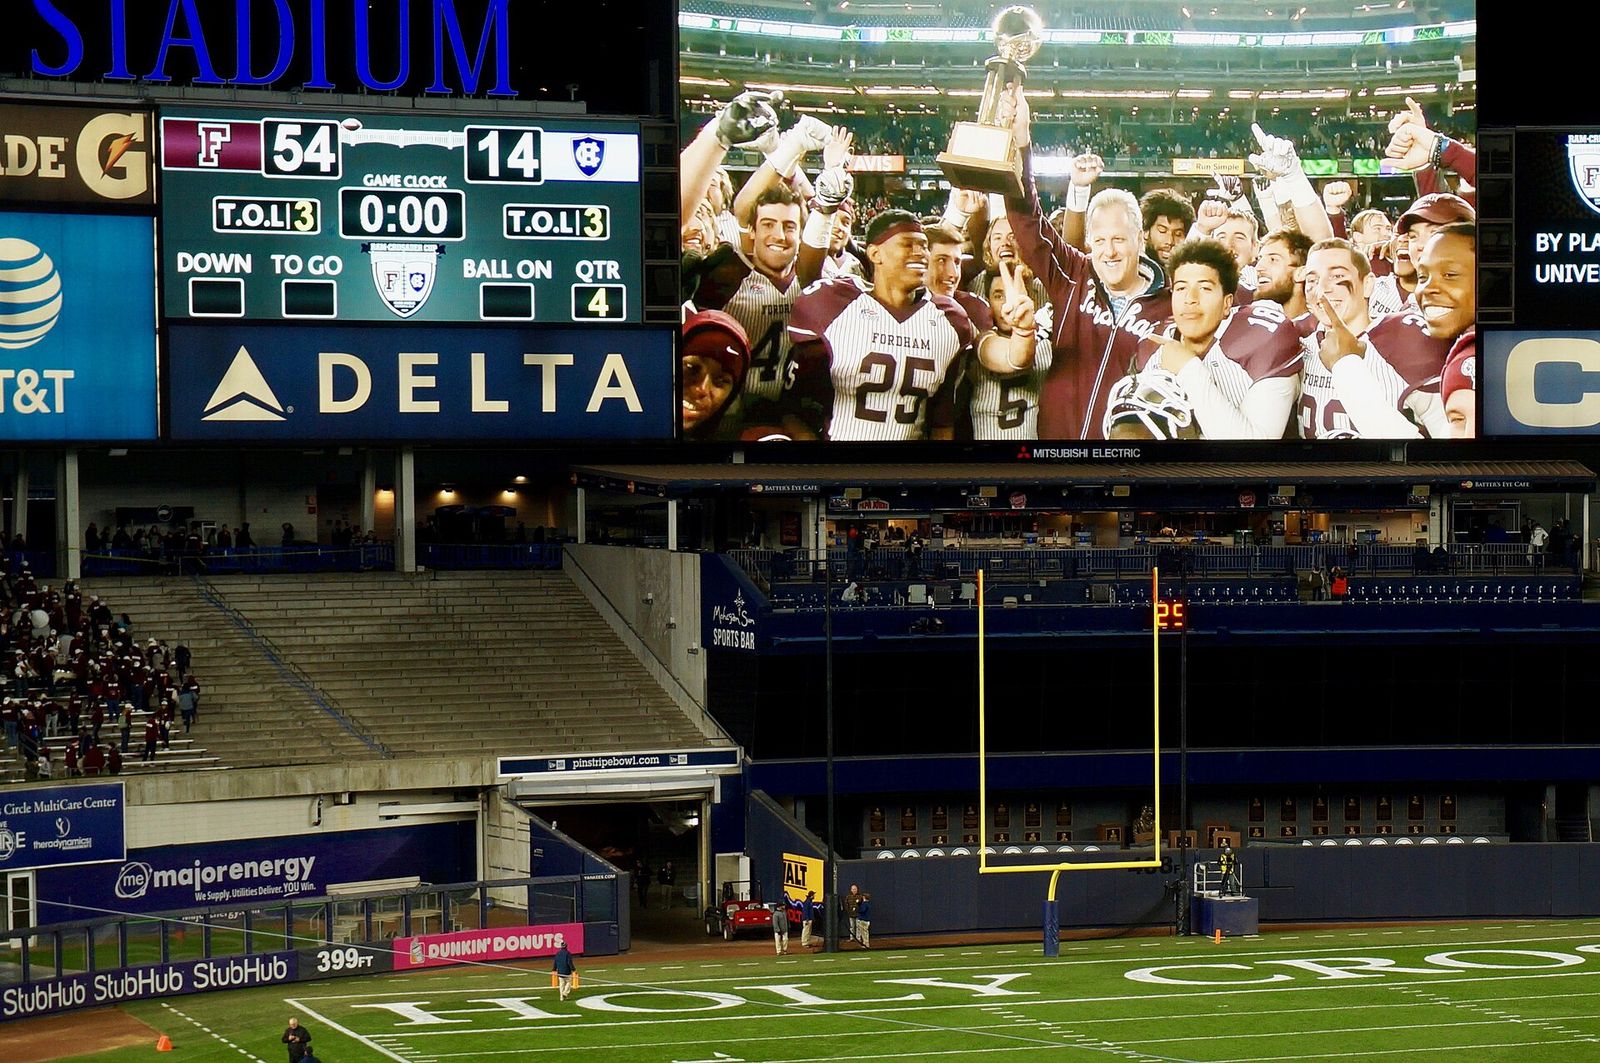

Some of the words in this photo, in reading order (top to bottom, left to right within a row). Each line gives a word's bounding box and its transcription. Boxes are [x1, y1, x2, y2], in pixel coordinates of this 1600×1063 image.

[31, 0, 518, 96] STADIUM
[0, 135, 66, 178] DE
[273, 124, 336, 172] 54
[478, 130, 540, 178] 14
[1196, 162, 1212, 171] Run
[1213, 162, 1239, 172] Simple
[363, 174, 401, 188] GAME
[403, 175, 447, 188] CLOCK
[293, 200, 315, 232] 3
[359, 194, 448, 234] 0:00
[583, 207, 604, 237] 3
[1536, 232, 1561, 252] BY
[177, 252, 251, 273] DOWN
[271, 254, 302, 274] TO
[308, 254, 343, 275] GO
[463, 259, 512, 279] BALL
[517, 260, 552, 279] ON
[575, 260, 620, 283] QTR
[1535, 263, 1600, 283] UNIVE
[588, 287, 609, 317] 4
[871, 332, 931, 351] FORDHAM
[319, 352, 643, 413] DELTA
[854, 351, 936, 424] 25
[1303, 373, 1335, 390] FORDH
[1033, 448, 1089, 459] MITSUBISHI
[1092, 448, 1141, 459] ELECTRIC
[1157, 603, 1183, 627] 25
[713, 628, 739, 648] SPORTS
[740, 631, 755, 649] BAR
[572, 756, 660, 769] pinstripebowl.com
[3, 802, 31, 815] Circle
[34, 798, 82, 813] MultiCare
[84, 797, 117, 808] Center
[123, 874, 145, 887] me
[195, 892, 206, 901] We
[207, 890, 231, 902] Supply.
[232, 887, 257, 898] Utilities
[258, 885, 283, 895] Deliver.
[283, 882, 299, 893] YOU
[300, 882, 316, 891] Win.
[429, 937, 490, 958] DUNKIN'
[493, 933, 564, 952] DONUTS
[94, 967, 184, 1001] StubHub
[193, 956, 288, 989] StubHub
[350, 972, 1040, 1026] HOLY
[1123, 943, 1600, 985] CRO
[3, 979, 86, 1016] StubHub
